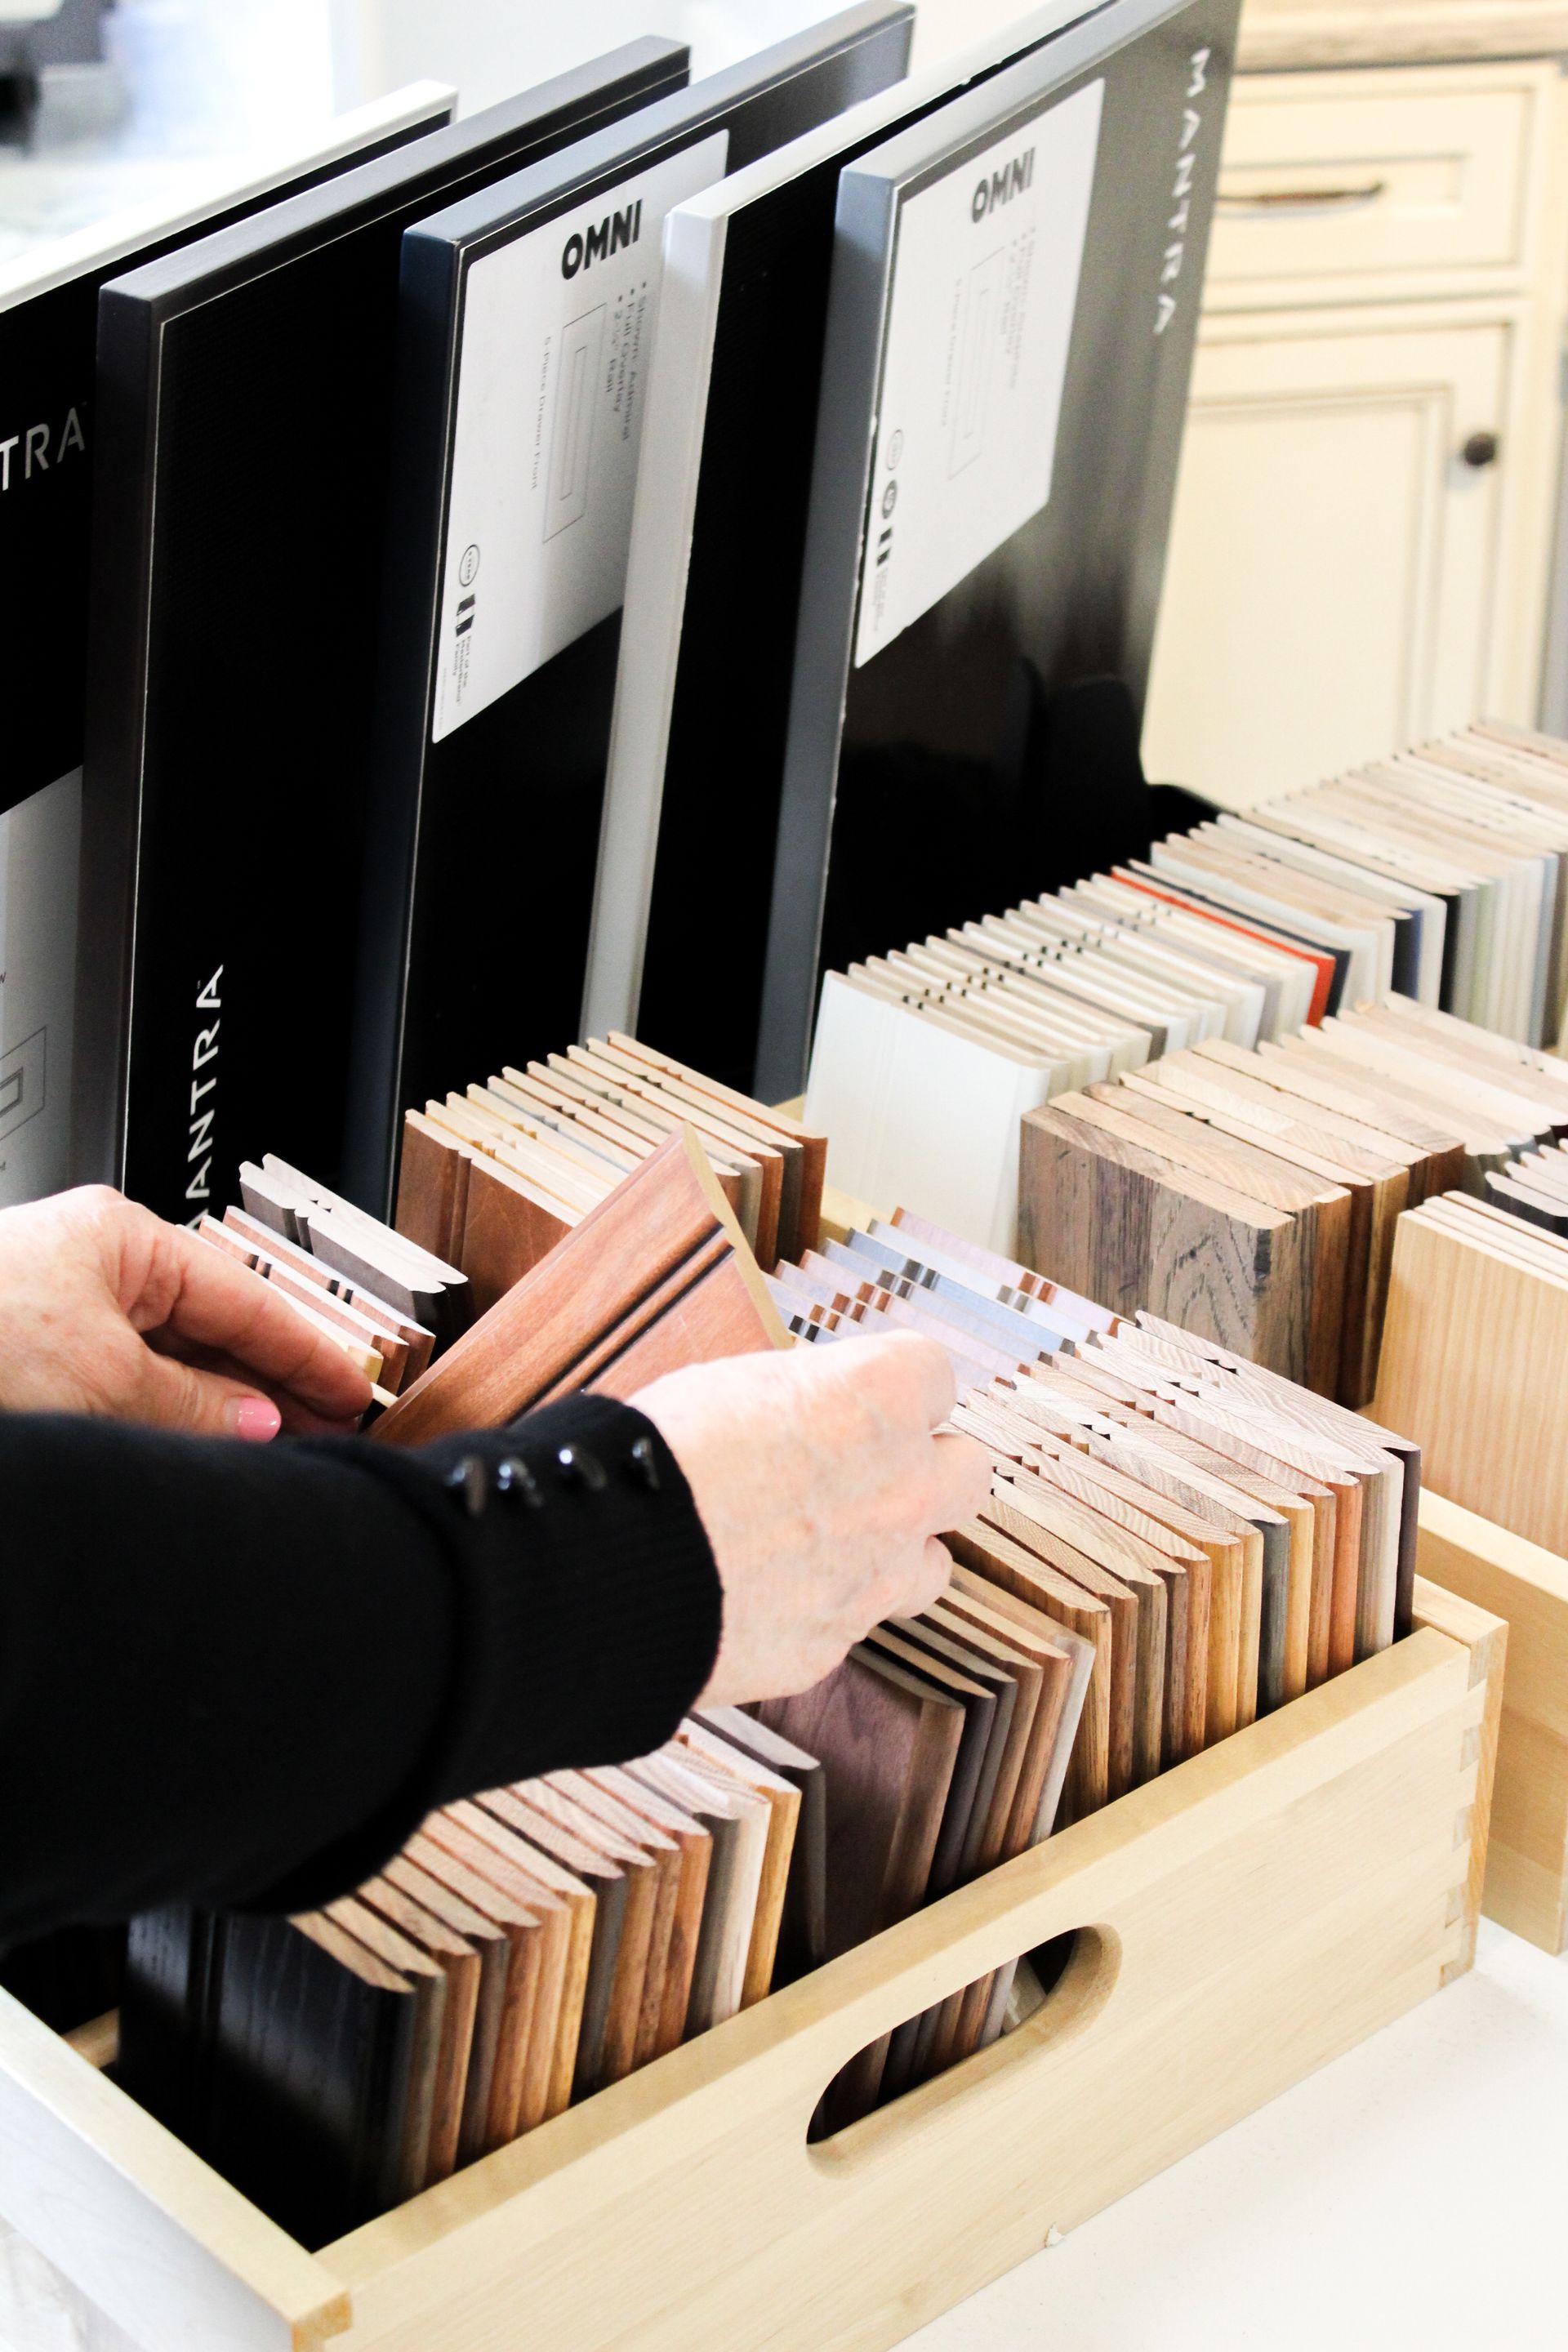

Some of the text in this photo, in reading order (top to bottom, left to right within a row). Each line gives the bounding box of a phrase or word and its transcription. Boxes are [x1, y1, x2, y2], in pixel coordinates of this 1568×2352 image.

[971, 146, 1036, 224] OMNI
[1154, 48, 1211, 336] MANTRA
[561, 198, 643, 280] OMNI
[613, 302, 635, 412] Full Overlay
